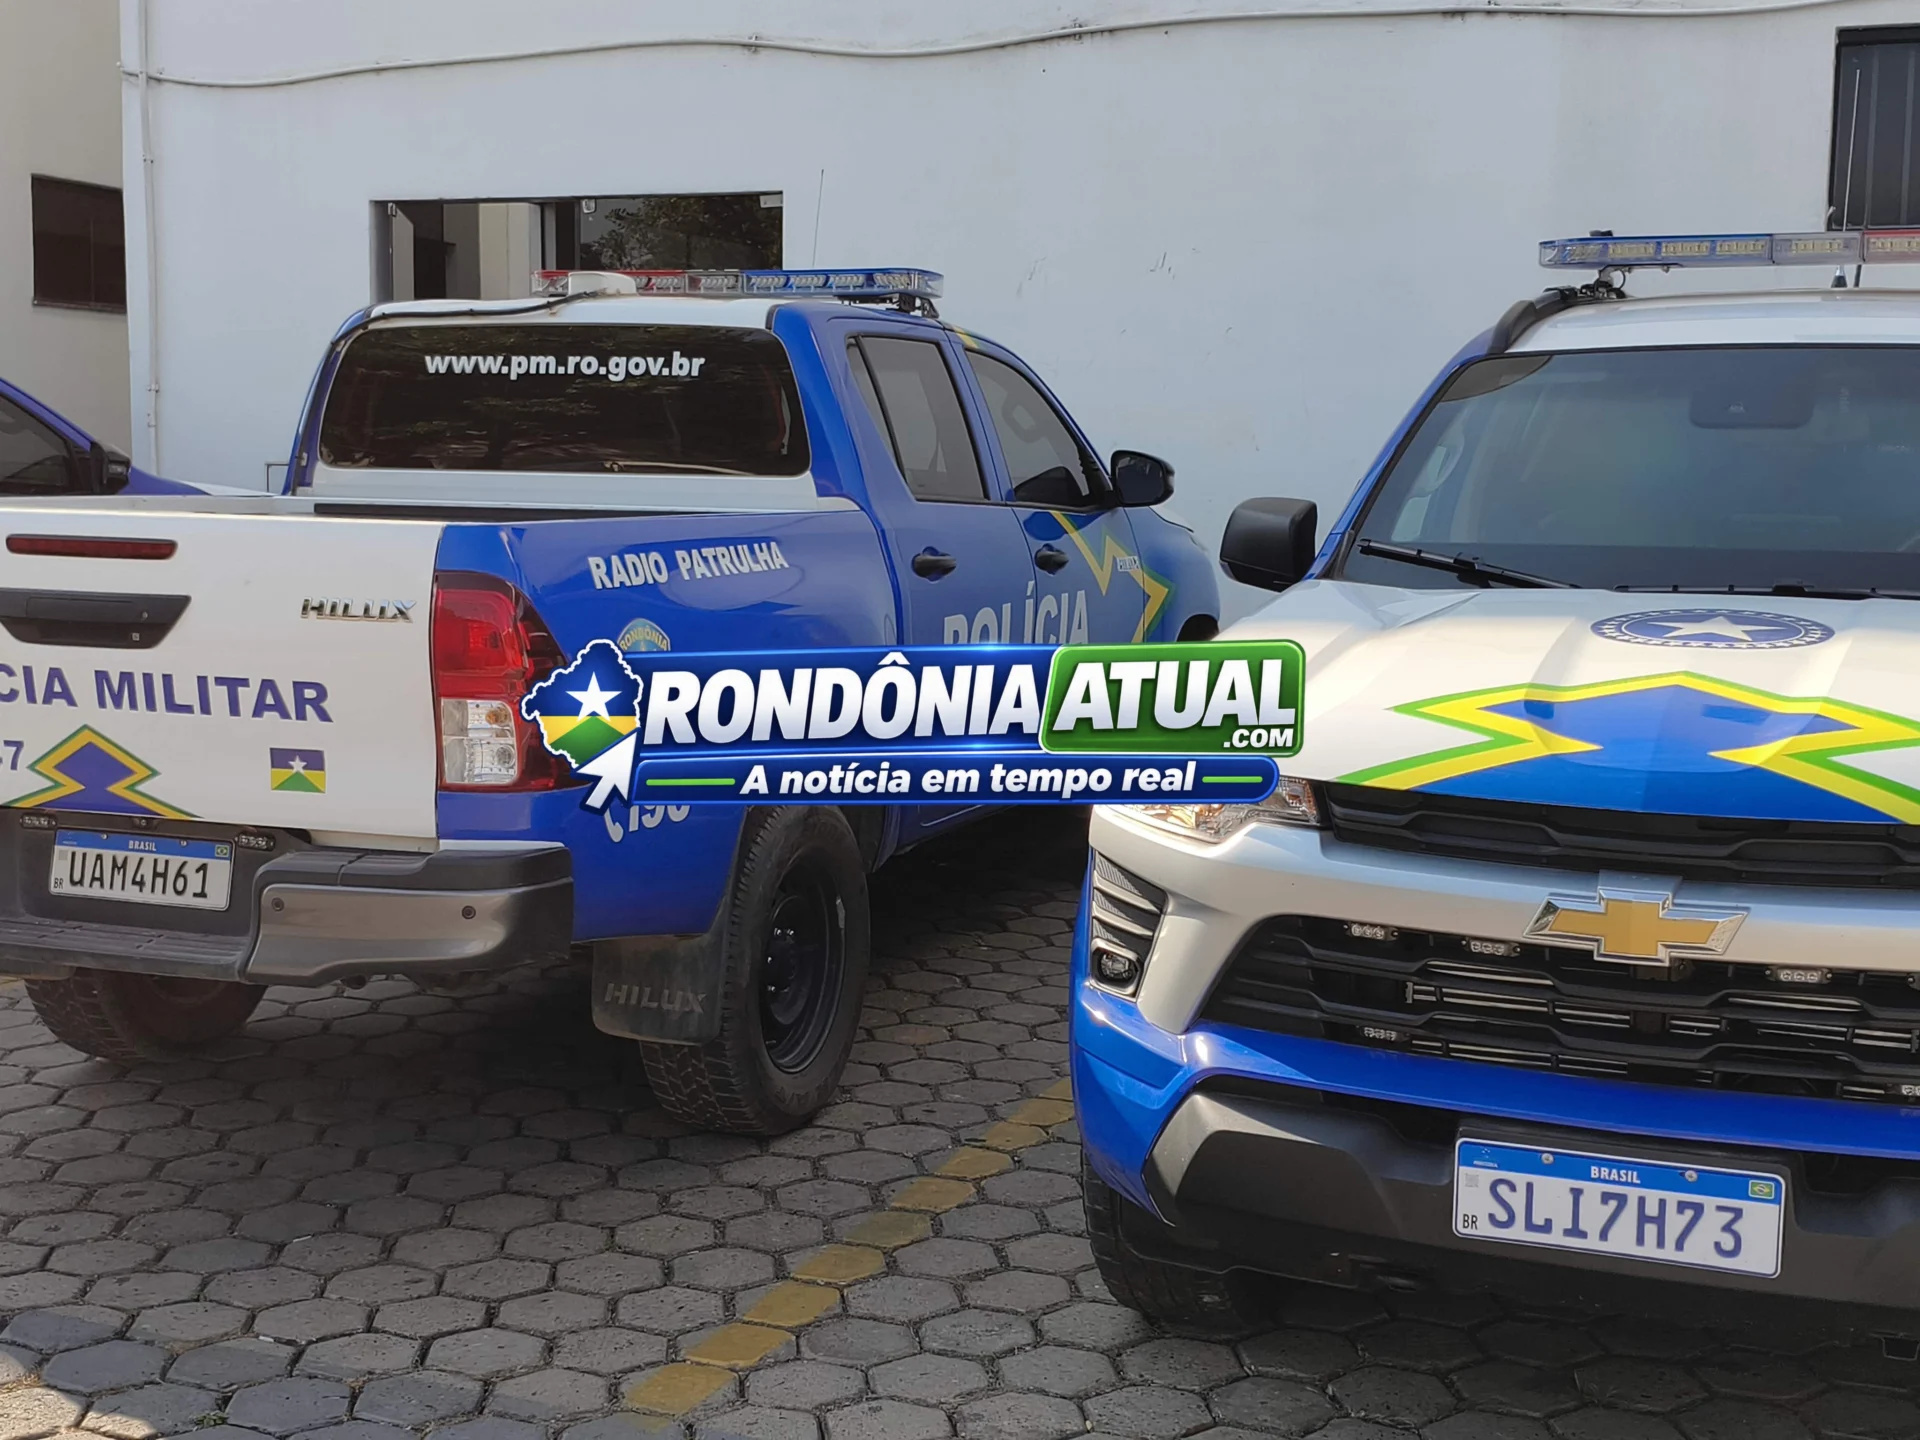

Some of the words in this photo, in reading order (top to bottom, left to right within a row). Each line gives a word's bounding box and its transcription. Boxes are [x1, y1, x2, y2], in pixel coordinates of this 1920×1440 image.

[425, 350, 705, 382] www.pm.ro.gov.br
[587, 551, 669, 590] RADIO
[674, 541, 790, 581] PATRULHA
[300, 596, 417, 624] HILUX
[94, 669, 334, 723] MILITAR
[128, 840, 157, 851] BRASIL
[53, 877, 64, 889] BR
[69, 851, 209, 898] UAM4H61
[603, 982, 707, 1013] HILUX
[1590, 1165, 1641, 1185] BRASIL
[1462, 1213, 1479, 1231] BR
[1487, 1178, 1744, 1259] SLI7H73
